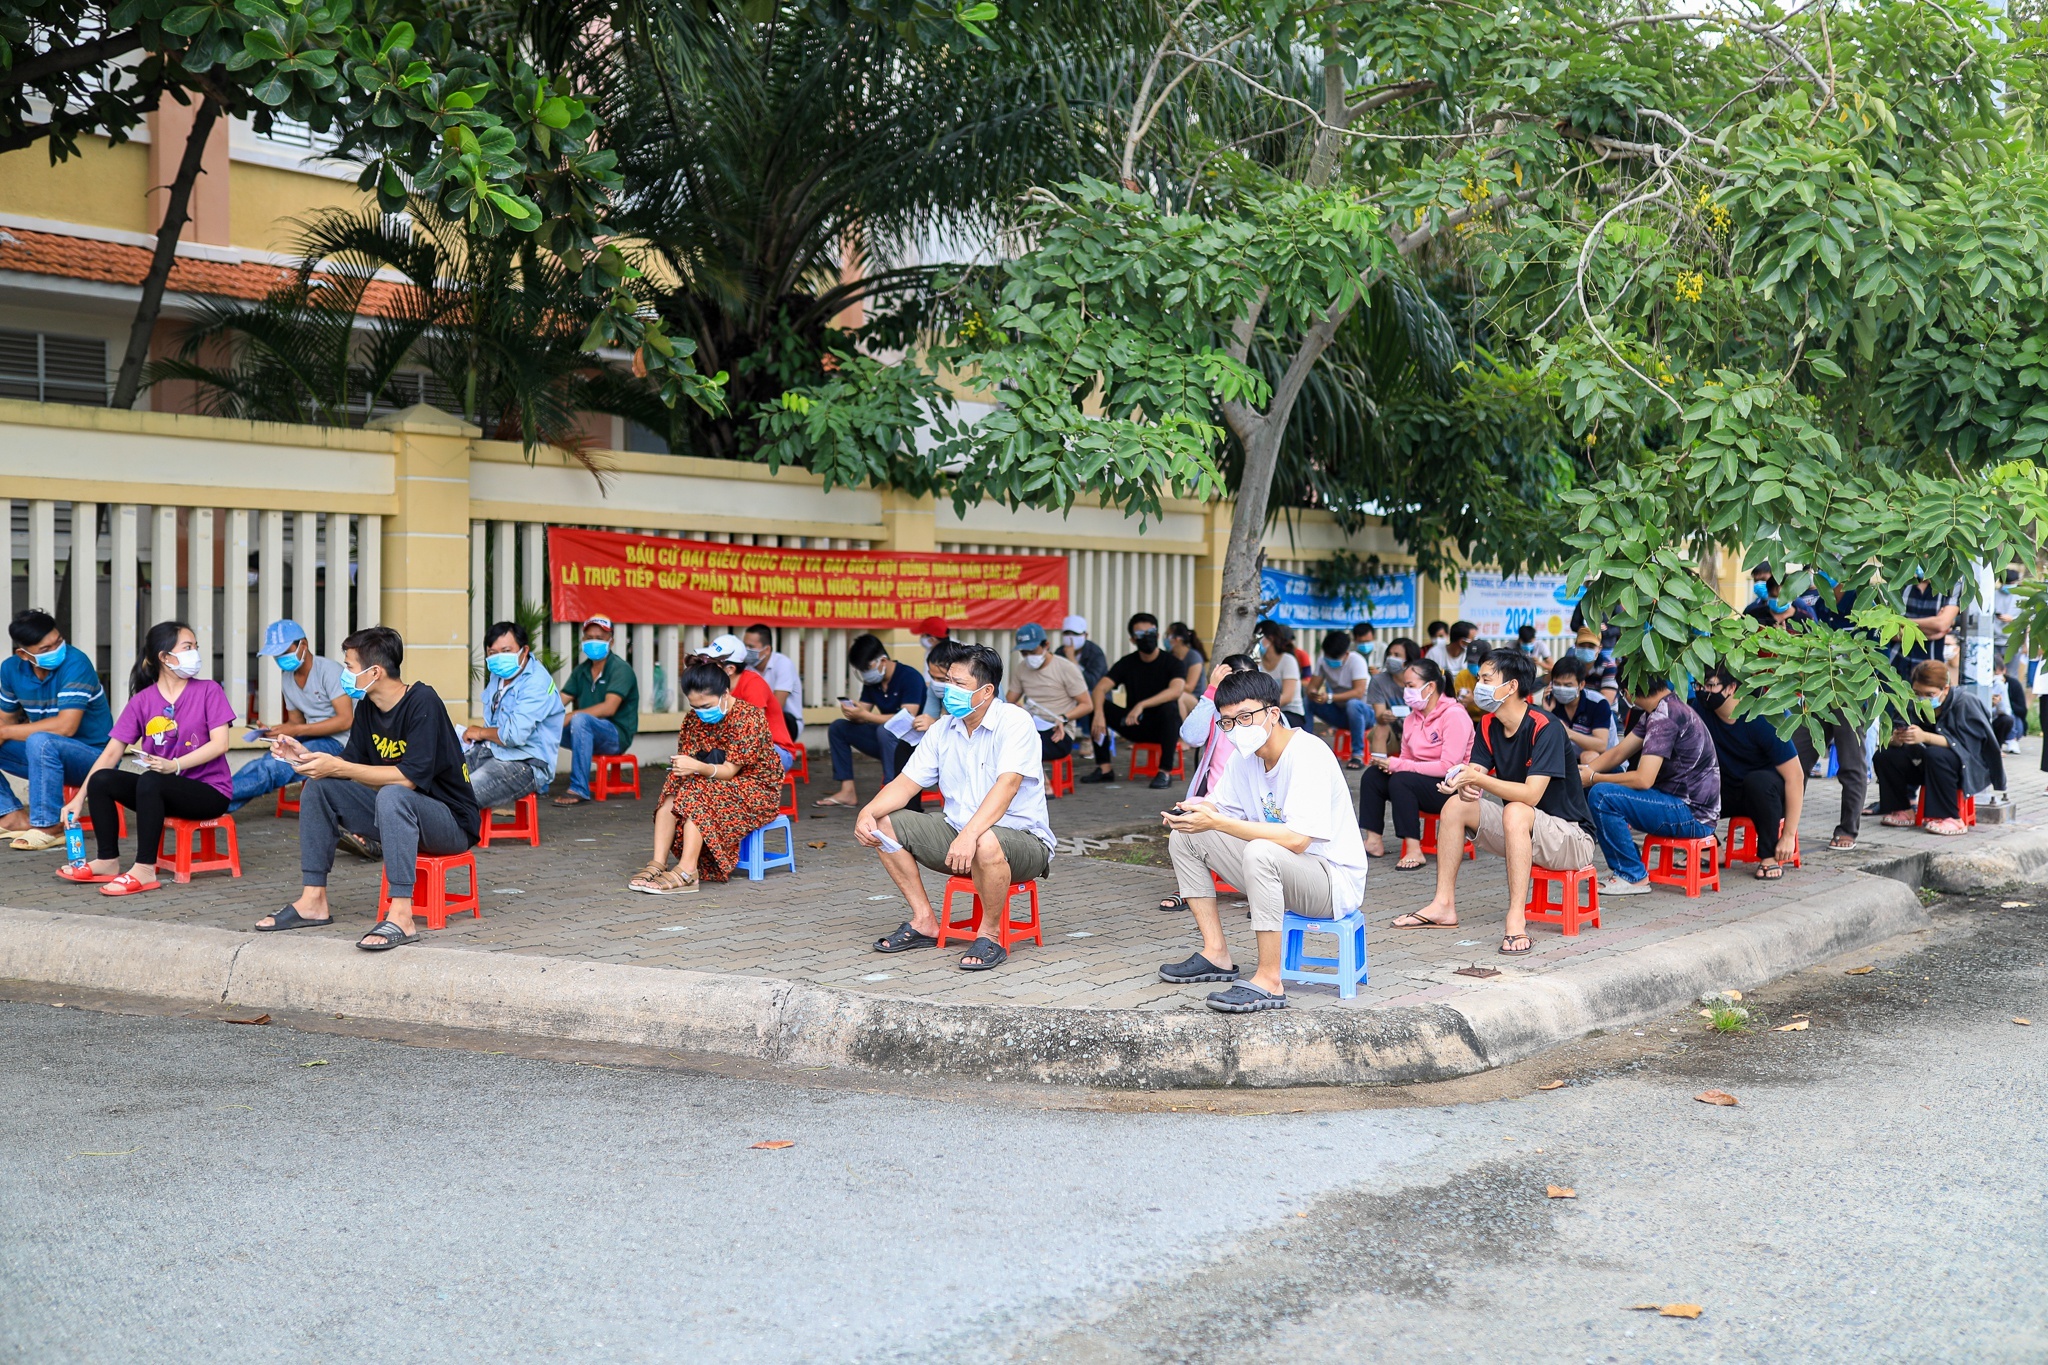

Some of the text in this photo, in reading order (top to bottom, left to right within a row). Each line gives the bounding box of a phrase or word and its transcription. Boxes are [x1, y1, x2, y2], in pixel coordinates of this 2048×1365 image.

[658, 543, 680, 566] CỬ
[681, 549, 706, 571] ĐẠI
[561, 561, 579, 585] LÀ
[583, 565, 621, 590] TRỰC
[624, 565, 655, 588] TIẾP
[658, 568, 687, 590] GÓP
[689, 568, 728, 592] PHẦN
[731, 571, 756, 593] XÂY
[760, 575, 796, 597] DỰNG
[797, 574, 825, 595] NHÀ
[827, 575, 860, 597] NƯỚC
[862, 576, 894, 597] PHÁP
[712, 592, 739, 616] CỦA
[741, 596, 779, 617] NHÂN
[782, 596, 811, 619] DÂN,
[815, 600, 832, 618] DO
[834, 598, 868, 619] NHÂN
[1505, 607, 1535, 635] 2021
